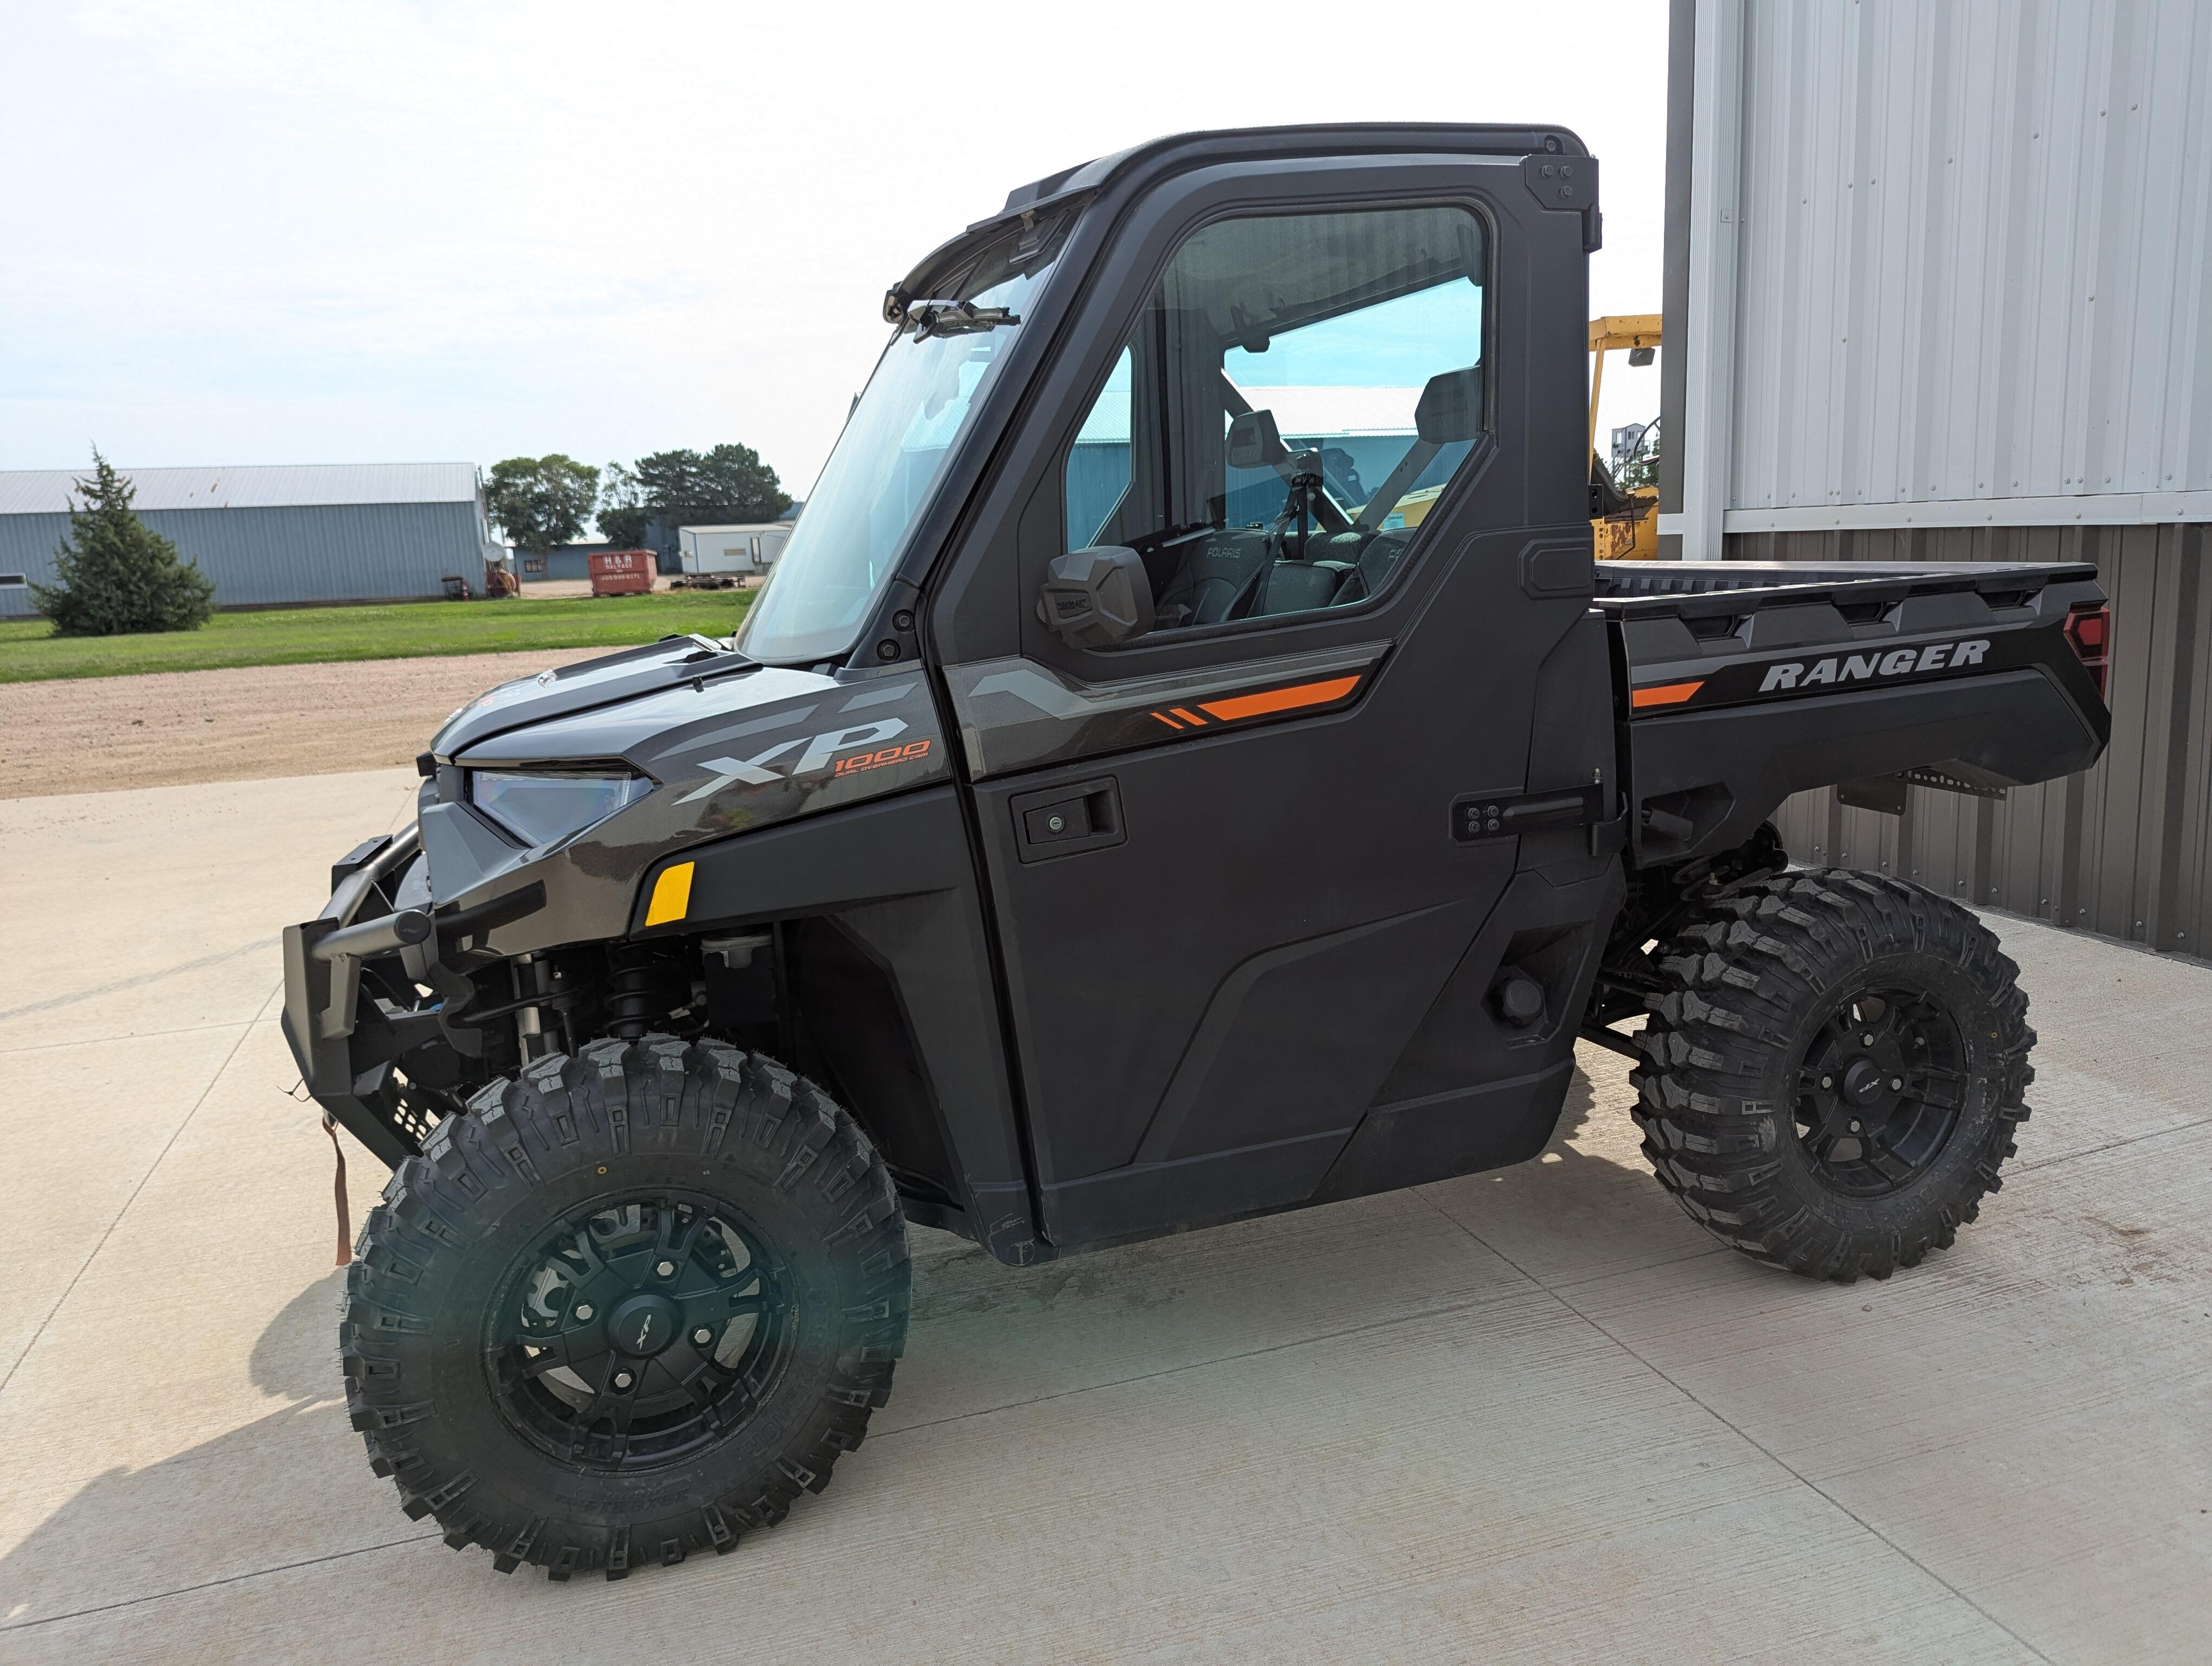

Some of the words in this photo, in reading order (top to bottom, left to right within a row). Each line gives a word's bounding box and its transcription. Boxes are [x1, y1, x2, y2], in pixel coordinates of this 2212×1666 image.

[603, 555, 612, 565] H
[615, 555, 622, 564] &
[624, 554, 632, 563] R
[1207, 547, 1241, 558] POLARIS
[1758, 640, 1990, 692] RANGER
[671, 717, 909, 806] XP
[834, 769, 859, 777] DUAL
[861, 758, 908, 771] OVERHEAD
[909, 752, 929, 760] CAM
[835, 740, 930, 772] 1000
[1859, 1078, 1880, 1092] XP
[636, 1315, 651, 1349] XP
